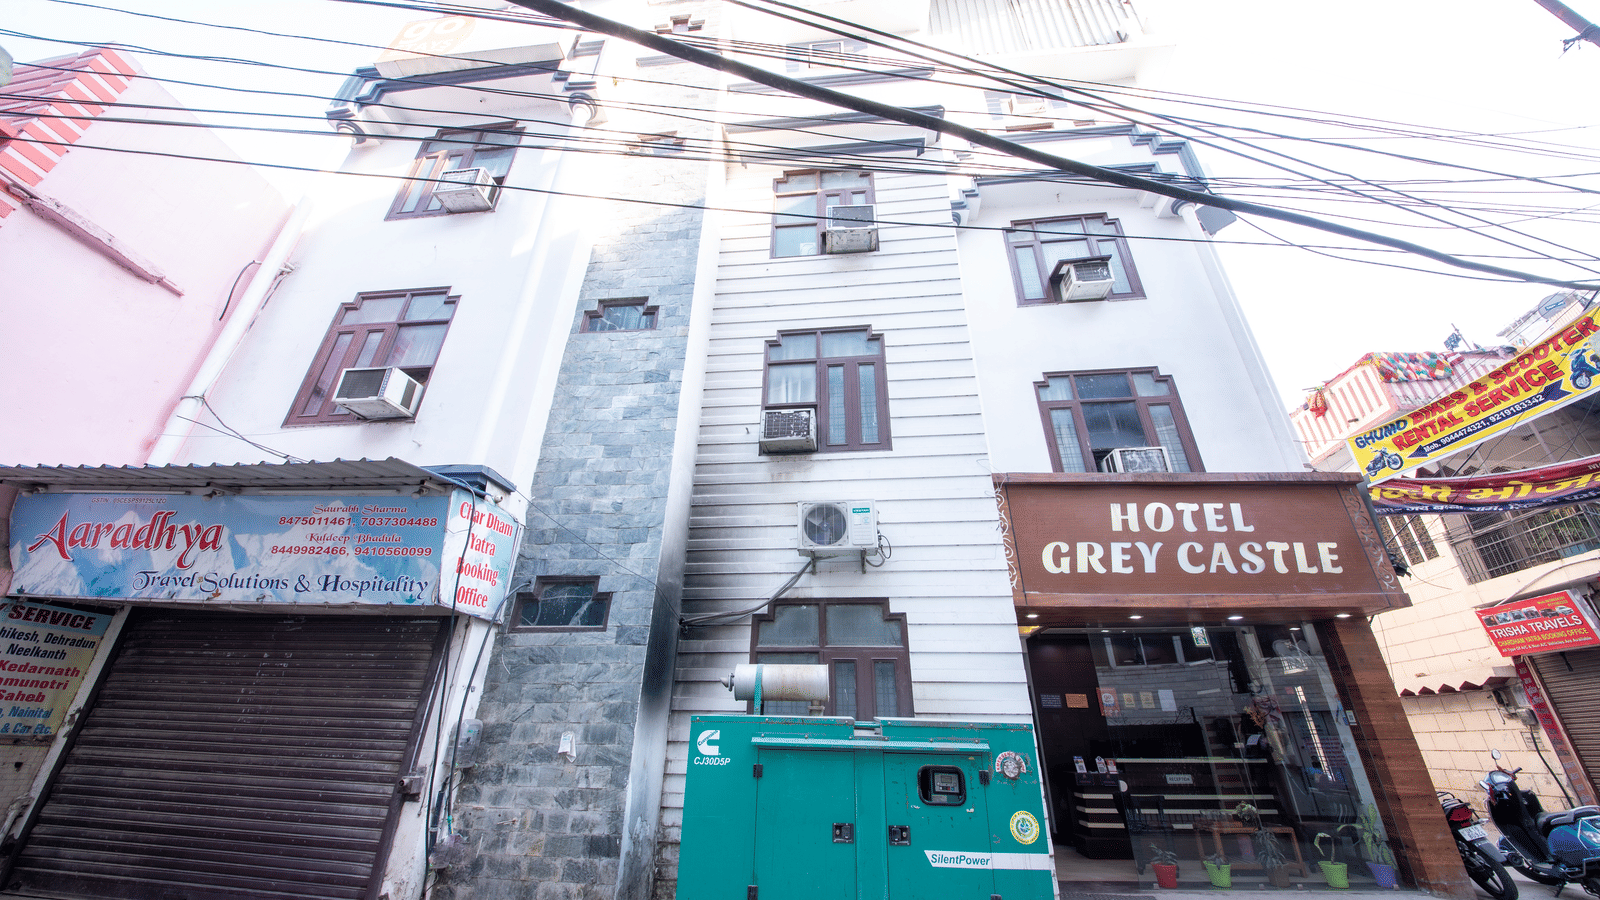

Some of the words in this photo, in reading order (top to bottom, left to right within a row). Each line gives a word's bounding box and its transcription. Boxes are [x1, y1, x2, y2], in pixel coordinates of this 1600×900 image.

[1355, 419, 1408, 449] GHUMO
[1408, 390, 1469, 425] BIKES
[1469, 381, 1489, 396] &
[1488, 316, 1600, 385] SCOOTER
[1392, 411, 1464, 451] RENTAL
[1463, 360, 1565, 418] SERVICE
[1423, 441, 1440, 453] Mob.
[1489, 394, 1545, 422] 9219183342
[312, 504, 359, 515] Saurabh
[362, 504, 407, 514] Sharma
[459, 501, 486, 525] Char
[486, 510, 514, 538] Dham
[1110, 502, 1254, 532] HOTEL
[278, 516, 355, 527] 8475011461,
[361, 517, 438, 527] 7037304488
[28, 509, 224, 569] Aaradhya
[305, 533, 350, 544] Kuldeep
[353, 534, 401, 544] Bhadula
[469, 532, 496, 557] Yatra
[271, 545, 350, 557] 8449982466,
[354, 546, 432, 557] 9410560099
[1041, 541, 1163, 574] GREY
[1176, 541, 1343, 574] CASTLE
[456, 557, 499, 587] Booking
[133, 571, 198, 590] Travel
[199, 572, 289, 592] Solutions
[294, 574, 310, 592] &
[318, 573, 429, 599] Hospitality
[457, 586, 489, 609] Office
[8, 605, 96, 630] SERVICE
[1490, 624, 1530, 639] TRISHA
[1528, 614, 1582, 633] TRAVELS
[43, 633, 96, 649] Dehradun
[1497, 639, 1525, 647] CHARDHAM
[1524, 635, 1540, 643] YATRA
[1540, 631, 1568, 641] BOOKING
[1567, 627, 1589, 637] OFFICE
[6, 643, 66, 660] Neelkanth
[0, 660, 80, 677] Kedarnath
[8, 706, 53, 718] Nainital
[0, 723, 10, 733] &
[13, 723, 32, 734] Car
[33, 724, 52, 734] Etc.
[694, 757, 730, 765] CJ30D5P
[930, 853, 991, 867] SilentPower
